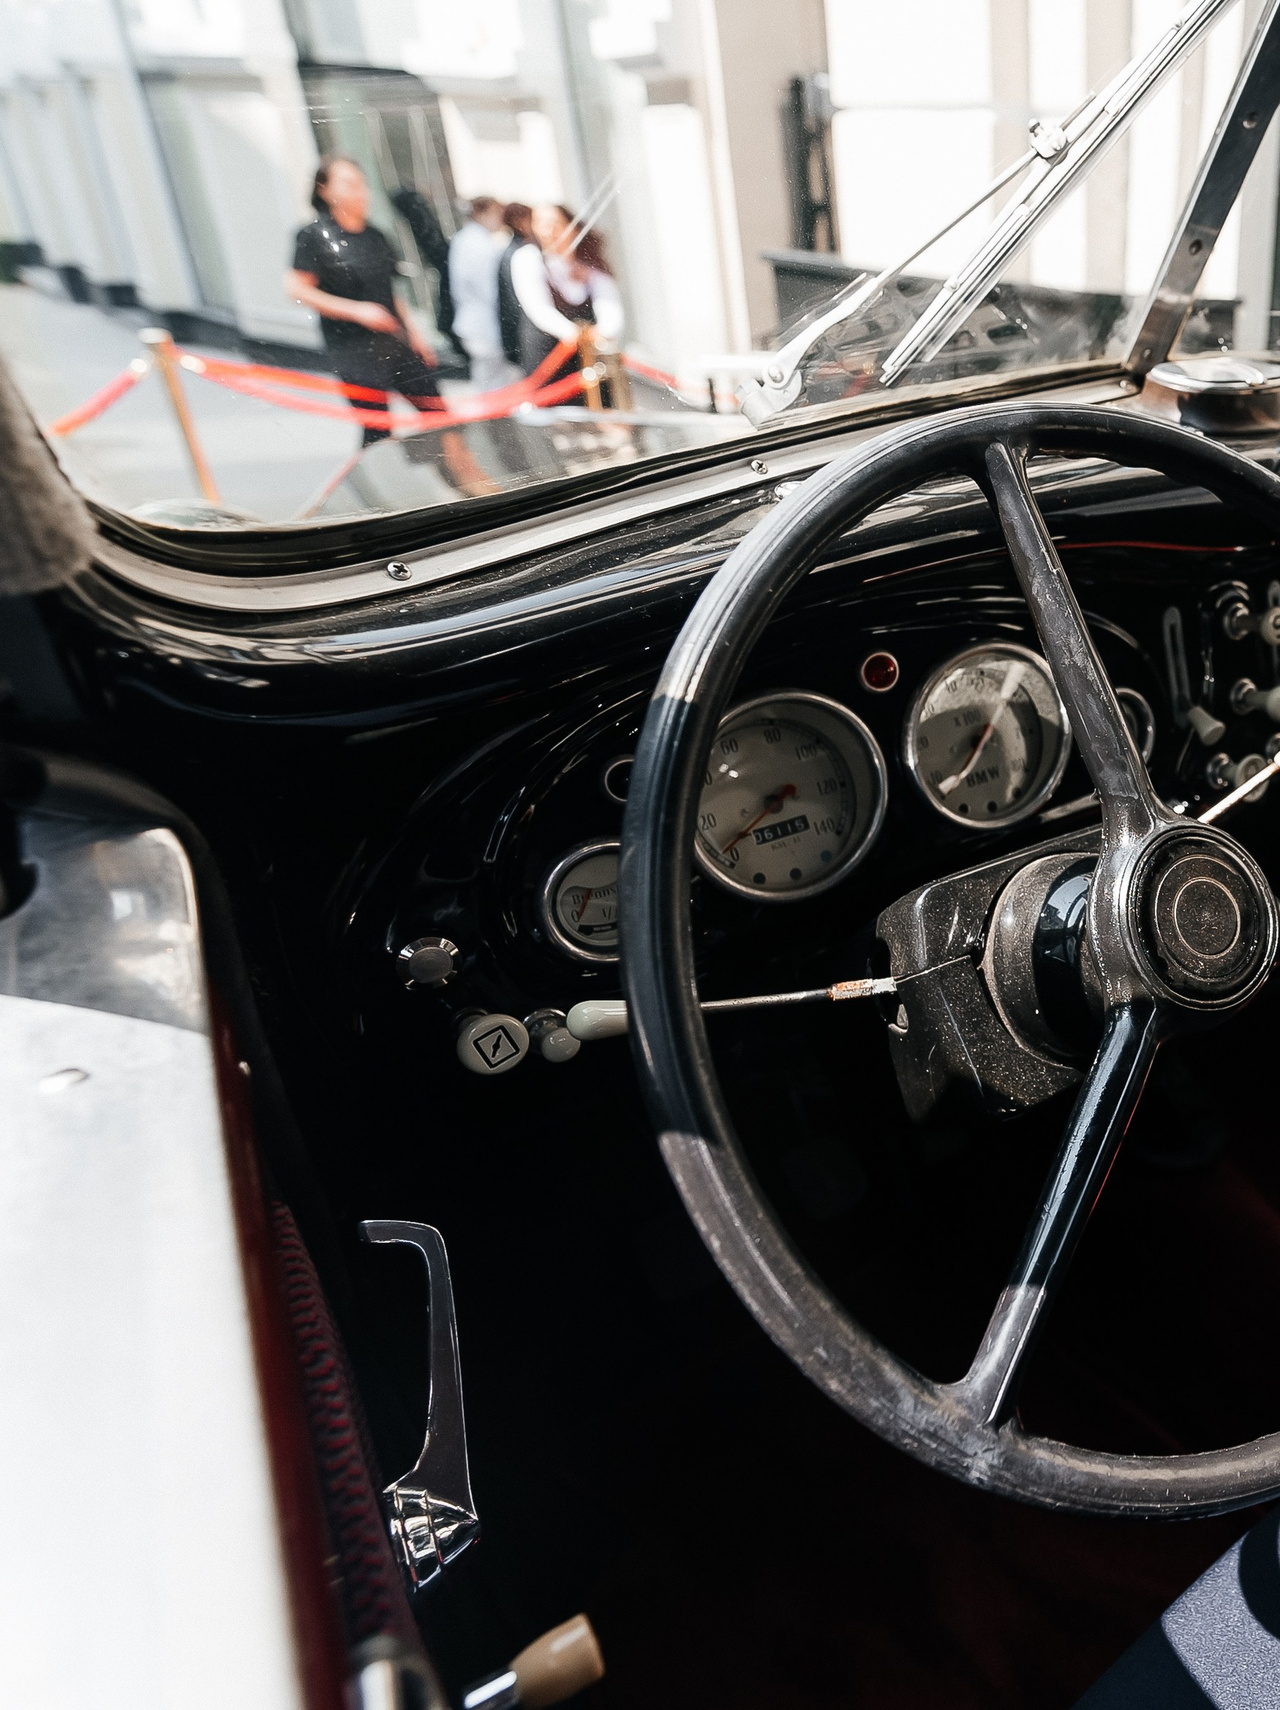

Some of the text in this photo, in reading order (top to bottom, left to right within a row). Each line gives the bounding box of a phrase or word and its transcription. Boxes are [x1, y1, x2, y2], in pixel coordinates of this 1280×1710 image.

[764, 728, 781, 744] 80
[720, 738, 738, 755] 60
[795, 744, 818, 761] 100
[966, 766, 1000, 788] BMW
[817, 778, 838, 795] 120
[700, 813, 716, 830] 20
[814, 819, 834, 835] 140
[729, 847, 740, 861] 0
